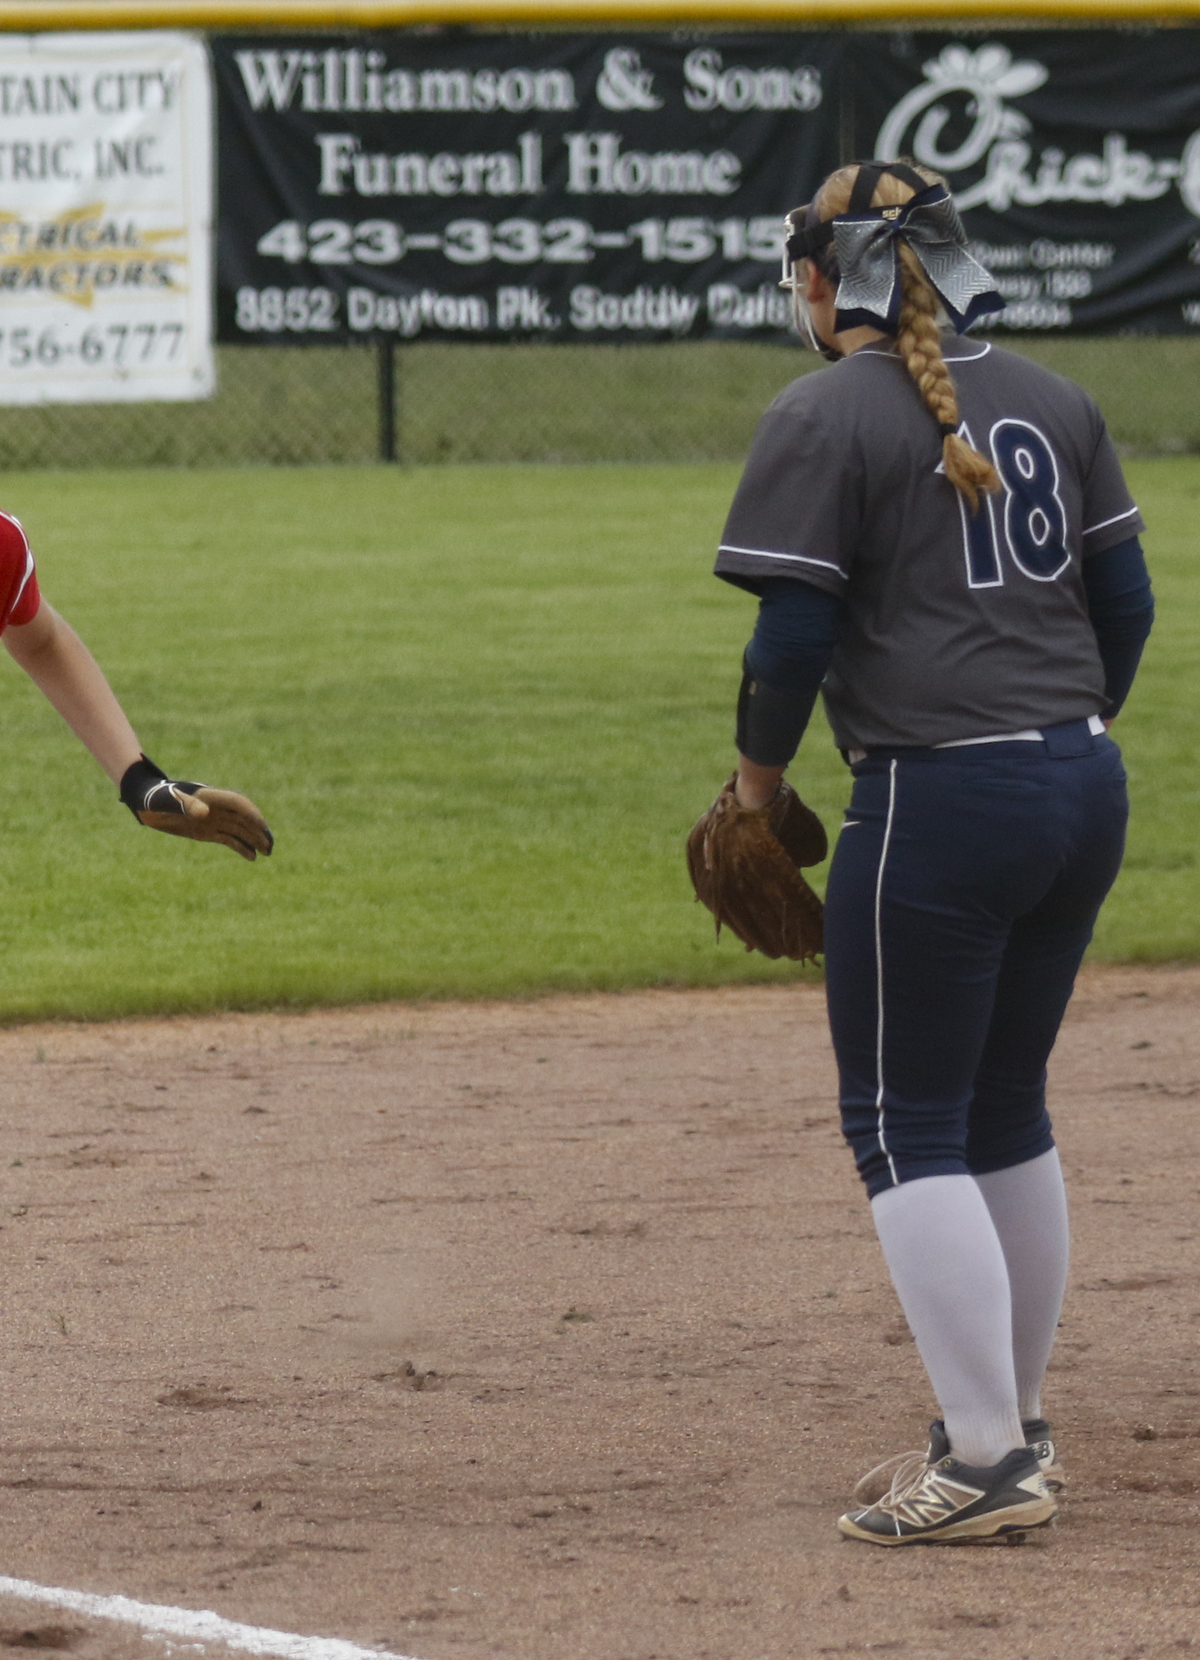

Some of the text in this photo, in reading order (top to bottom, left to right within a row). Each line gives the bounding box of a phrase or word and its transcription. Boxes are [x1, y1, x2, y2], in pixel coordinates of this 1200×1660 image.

[92, 71, 176, 114] CITY
[234, 47, 823, 113] Williamson & Sons
[96, 135, 164, 178] INC.
[315, 131, 742, 196] Funeral Home
[256, 217, 787, 265] 423-332-1515
[347, 287, 490, 337] Dayton
[934, 418, 1071, 588] 18
